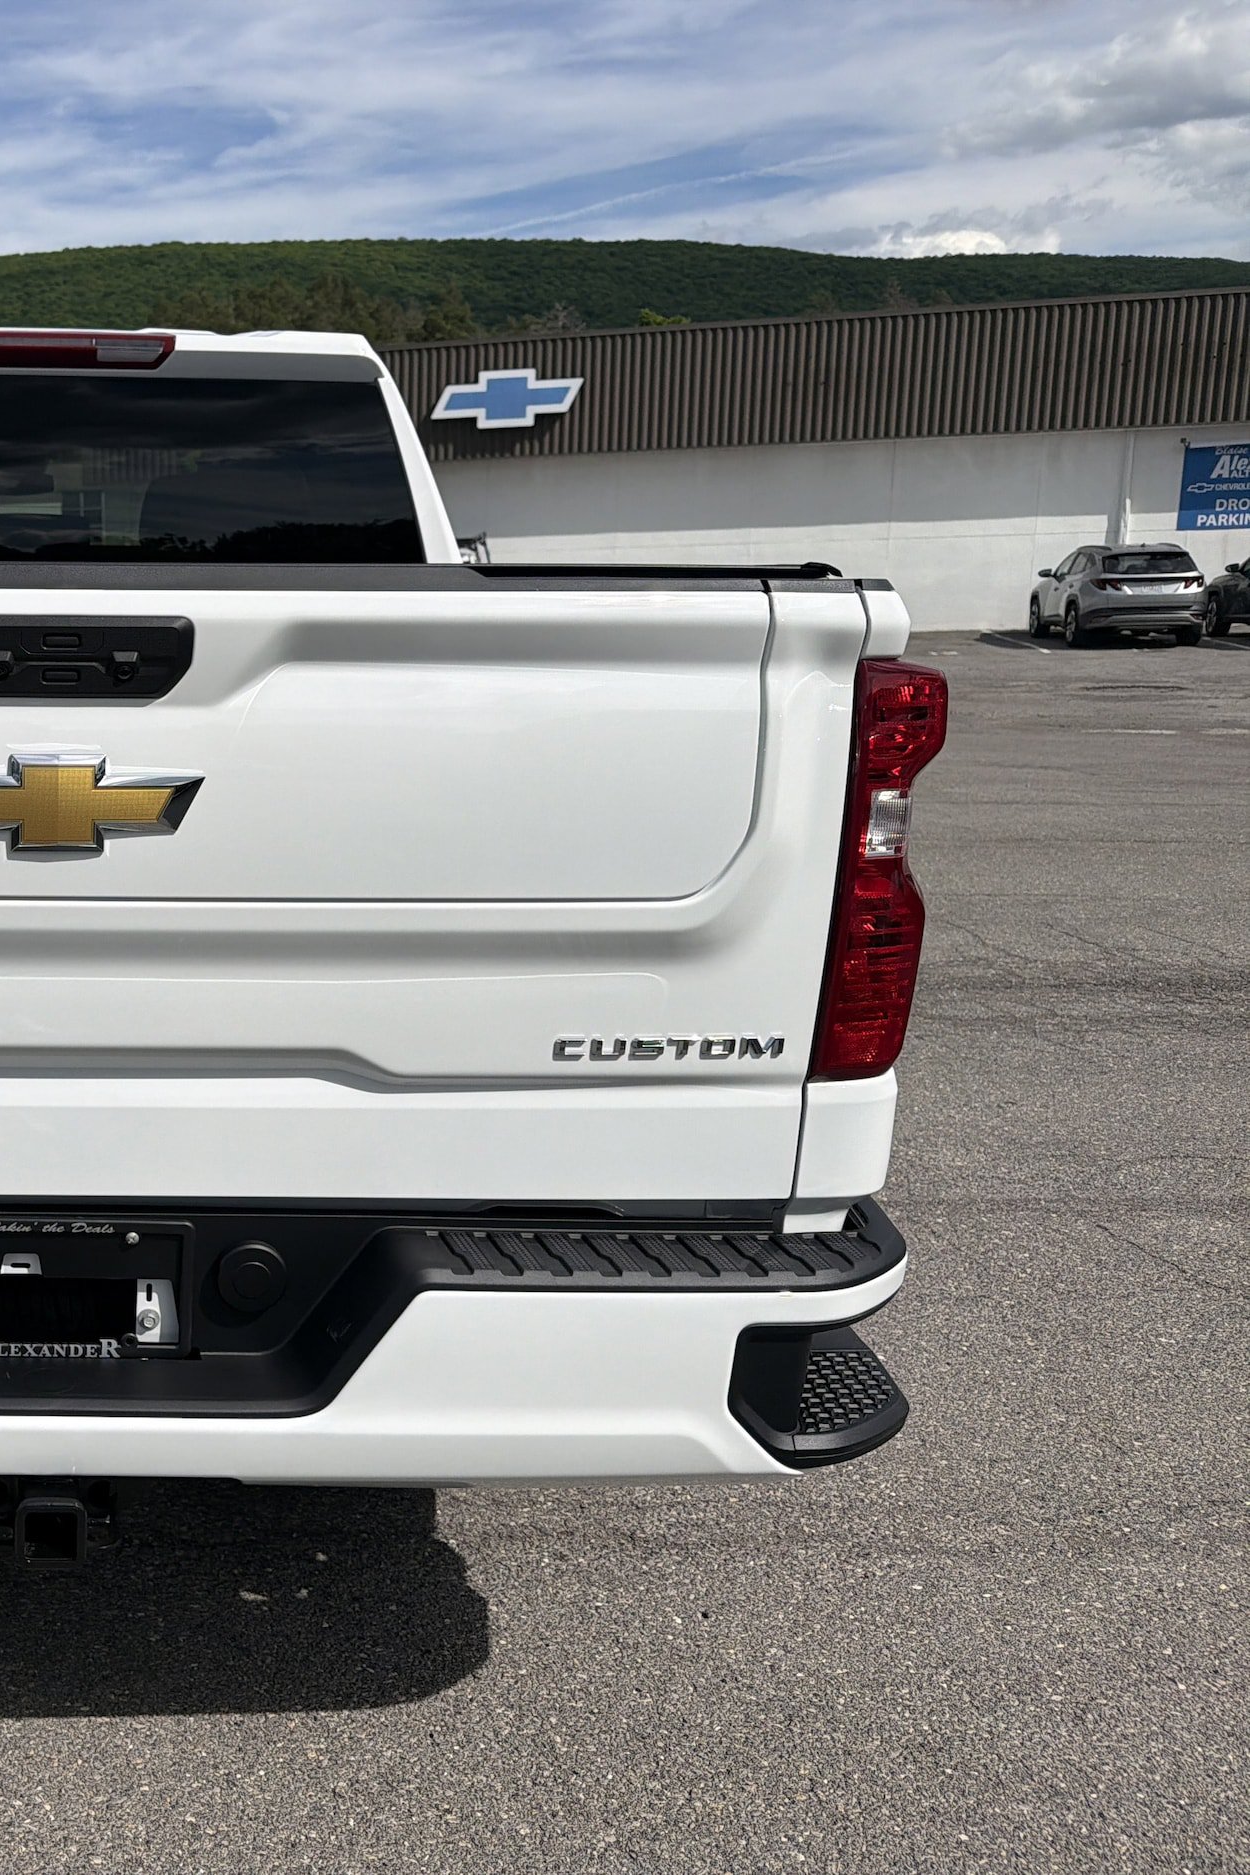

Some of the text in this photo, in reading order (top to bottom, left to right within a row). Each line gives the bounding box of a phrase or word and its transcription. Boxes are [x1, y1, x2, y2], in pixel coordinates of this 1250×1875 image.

[1214, 446, 1248, 455] Blaise
[1210, 454, 1250, 479] Ale
[1215, 498, 1250, 511] DRO
[552, 1034, 786, 1061] CUSTOM
[42, 1222, 65, 1233] the
[71, 1222, 115, 1234] Deals
